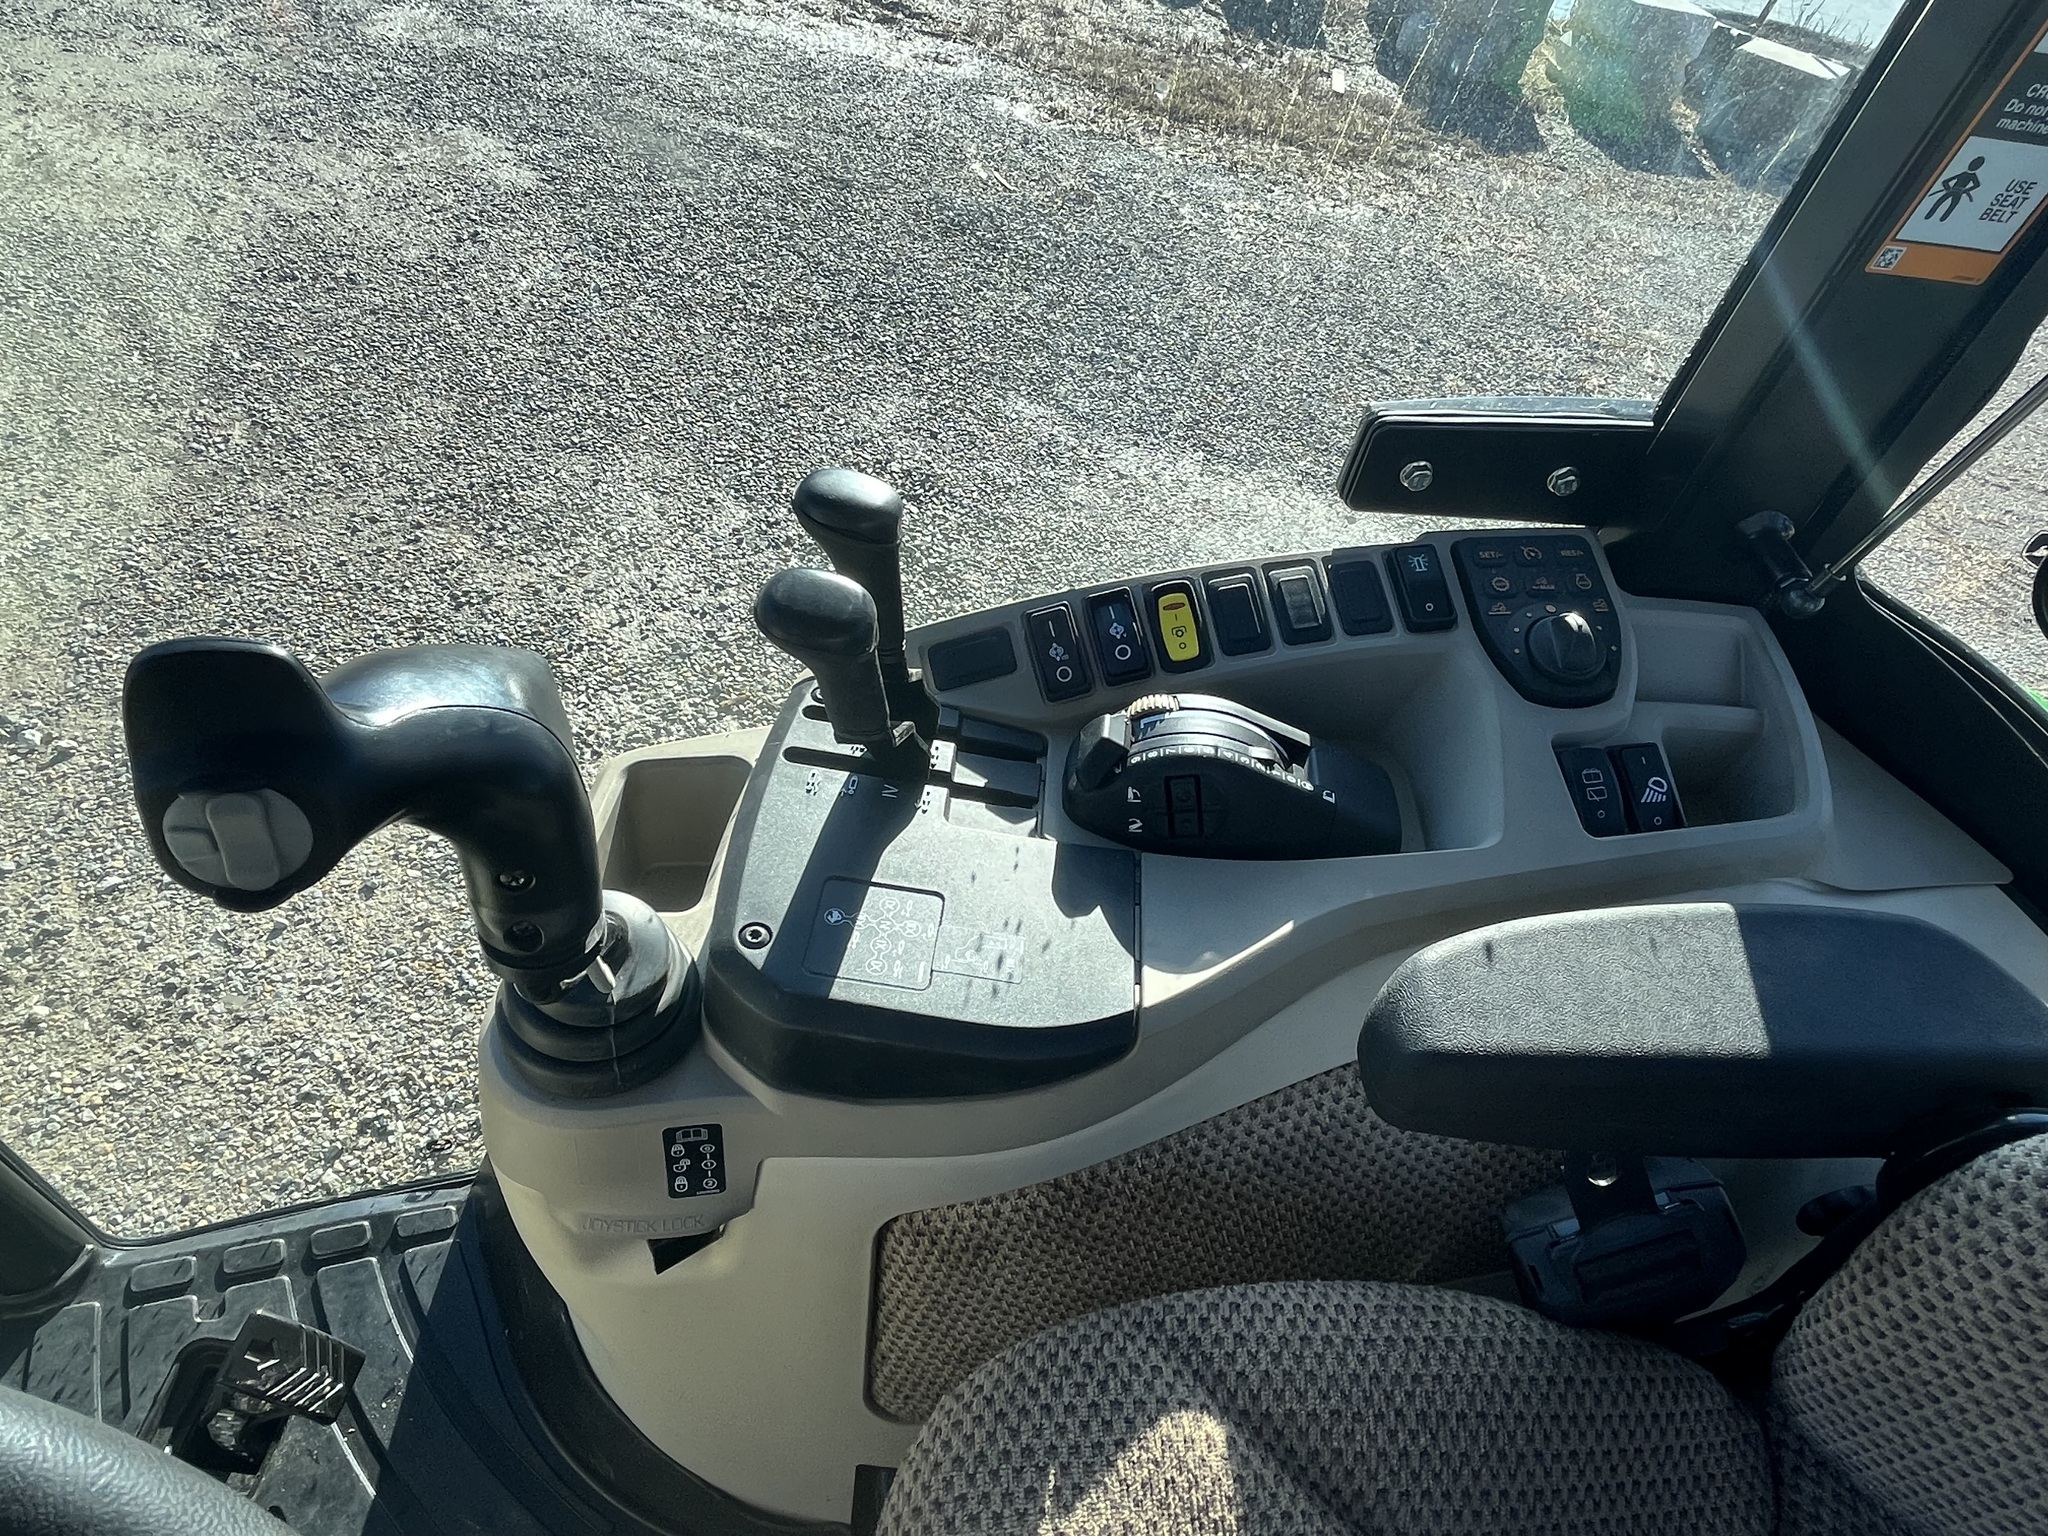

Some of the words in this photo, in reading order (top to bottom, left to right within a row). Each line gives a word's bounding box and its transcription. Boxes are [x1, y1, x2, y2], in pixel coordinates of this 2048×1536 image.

[2026, 83, 2048, 100] CR
[2003, 98, 2025, 113] Do
[2005, 178, 2038, 195] USE
[1990, 193, 2030, 209] SEAT
[1978, 207, 2018, 223] BELT
[582, 1217, 658, 1233] JOYSTICK
[662, 1214, 705, 1232] LOCK
